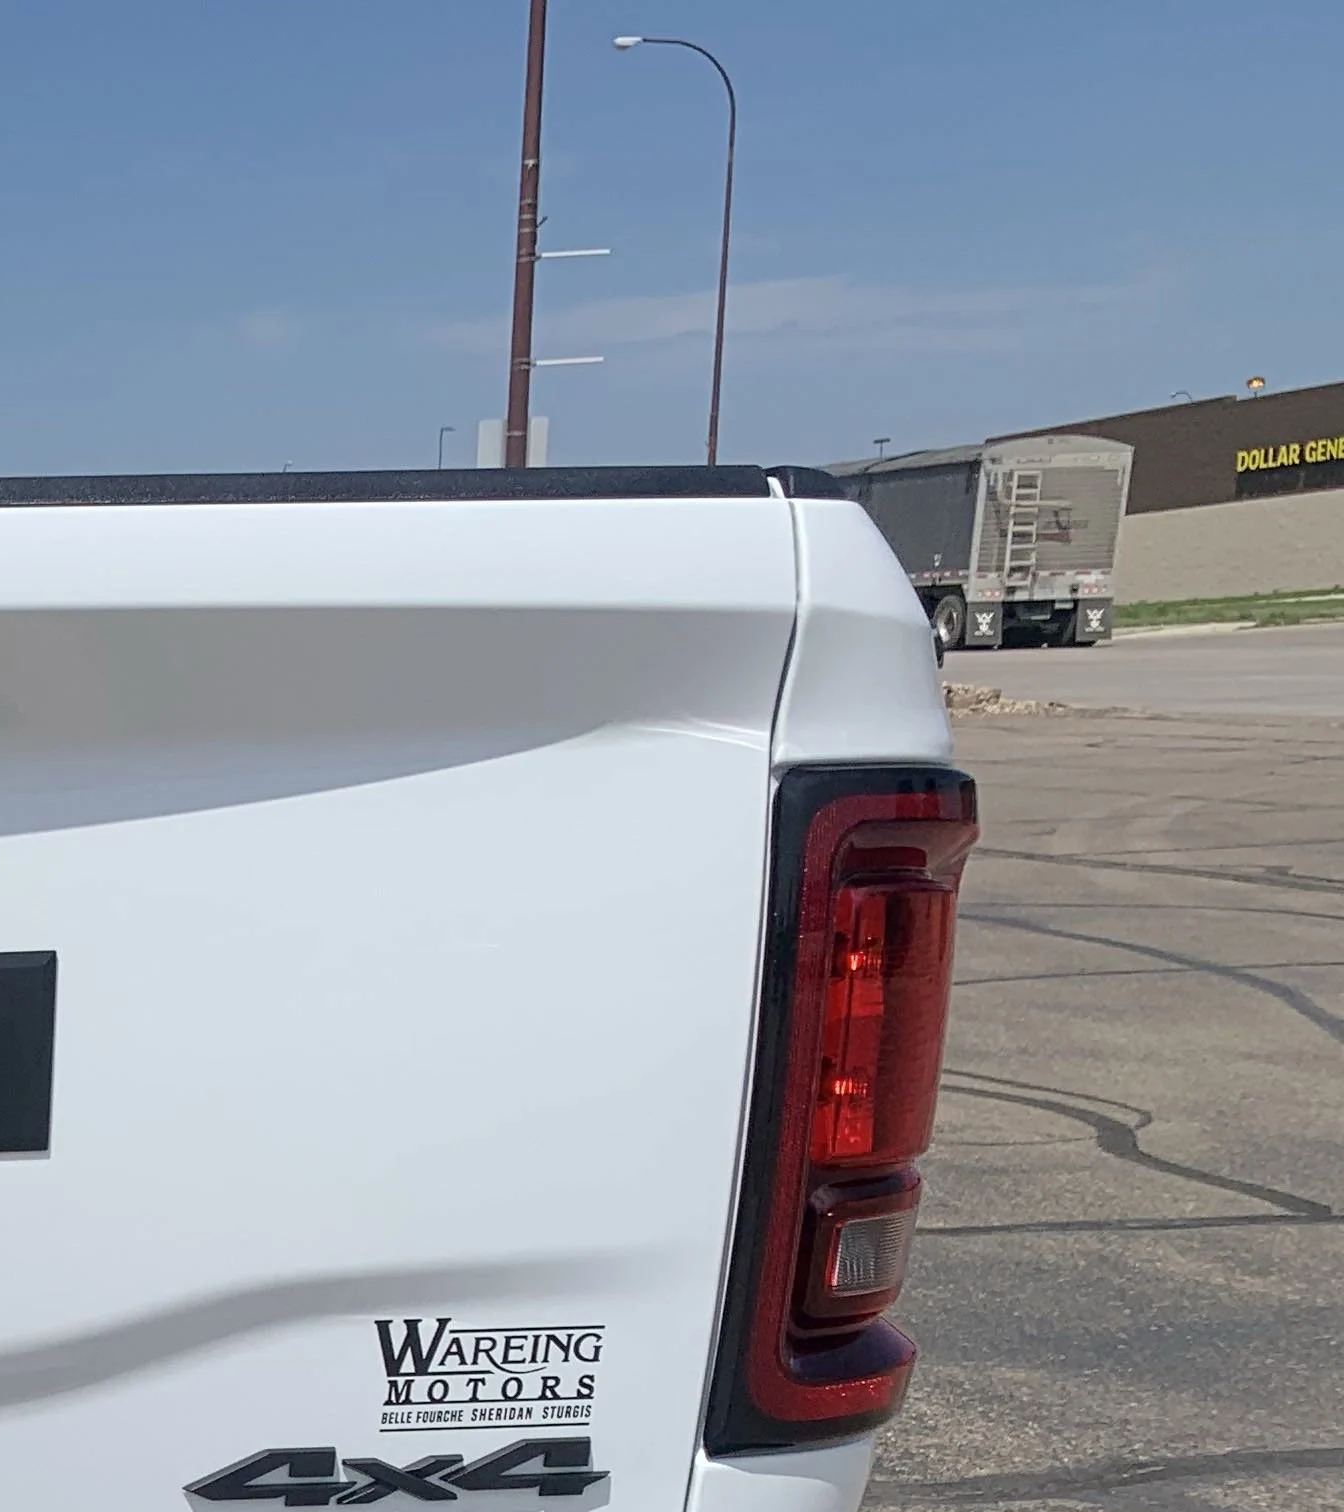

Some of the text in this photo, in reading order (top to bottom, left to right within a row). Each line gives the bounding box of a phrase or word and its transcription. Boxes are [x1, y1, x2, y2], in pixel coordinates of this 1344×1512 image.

[1236, 443, 1301, 473] DOLLAR
[374, 1317, 603, 1376] WAREING
[383, 1375, 595, 1405] MOTORS
[381, 1405, 592, 1425] BELLE FOURCHE SHERIDAN STURGIS
